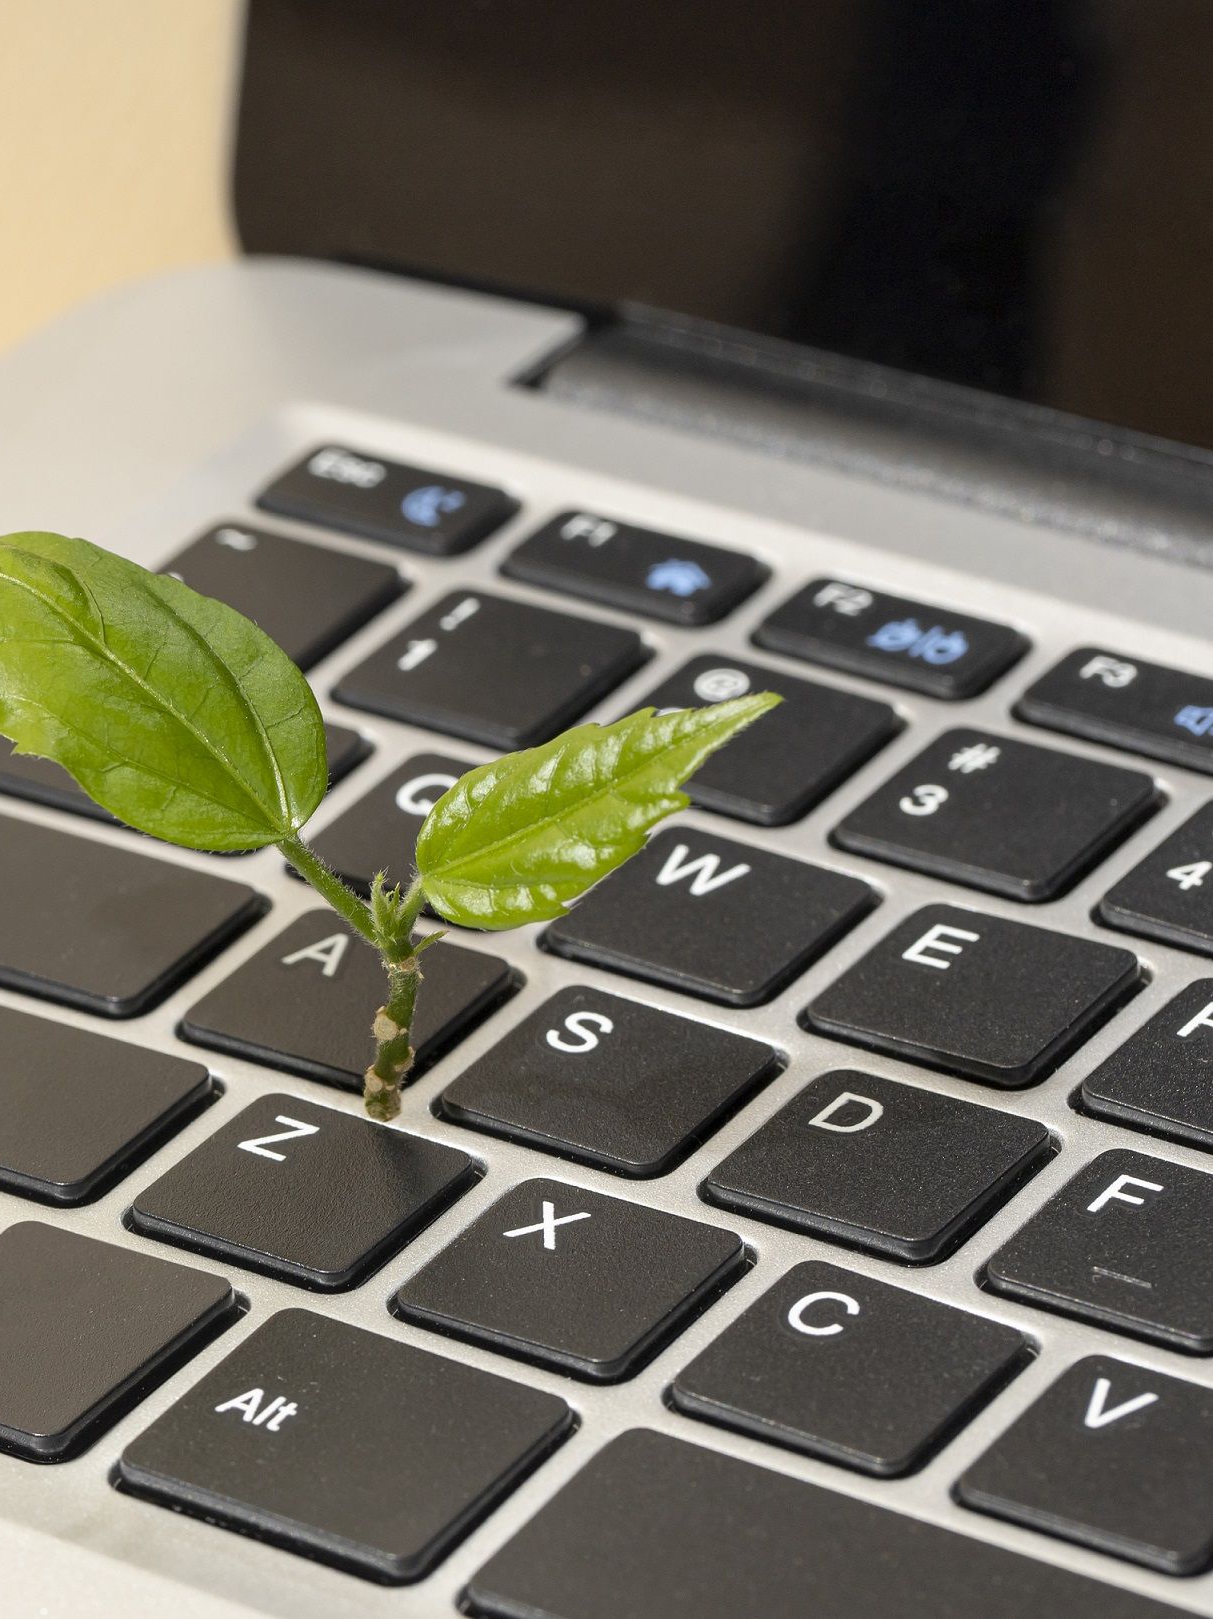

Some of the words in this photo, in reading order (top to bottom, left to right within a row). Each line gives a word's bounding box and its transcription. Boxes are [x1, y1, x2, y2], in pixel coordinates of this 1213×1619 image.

[307, 445, 387, 487] Esc
[560, 512, 617, 547] F1
[814, 581, 873, 616] F2
[1080, 655, 1137, 688] F3
[948, 743, 1001, 774] #
[899, 784, 949, 816] 3
[656, 844, 751, 896] W
[1166, 861, 1213, 890] 4
[281, 933, 349, 977] A
[902, 924, 980, 970] E
[546, 1011, 614, 1053] S
[809, 1092, 883, 1133] D
[237, 1115, 320, 1161] Z
[1087, 1174, 1164, 1213] F
[503, 1201, 592, 1250] X
[787, 1291, 860, 1336] C
[215, 1388, 297, 1432] Alt
[1085, 1377, 1159, 1429] V
